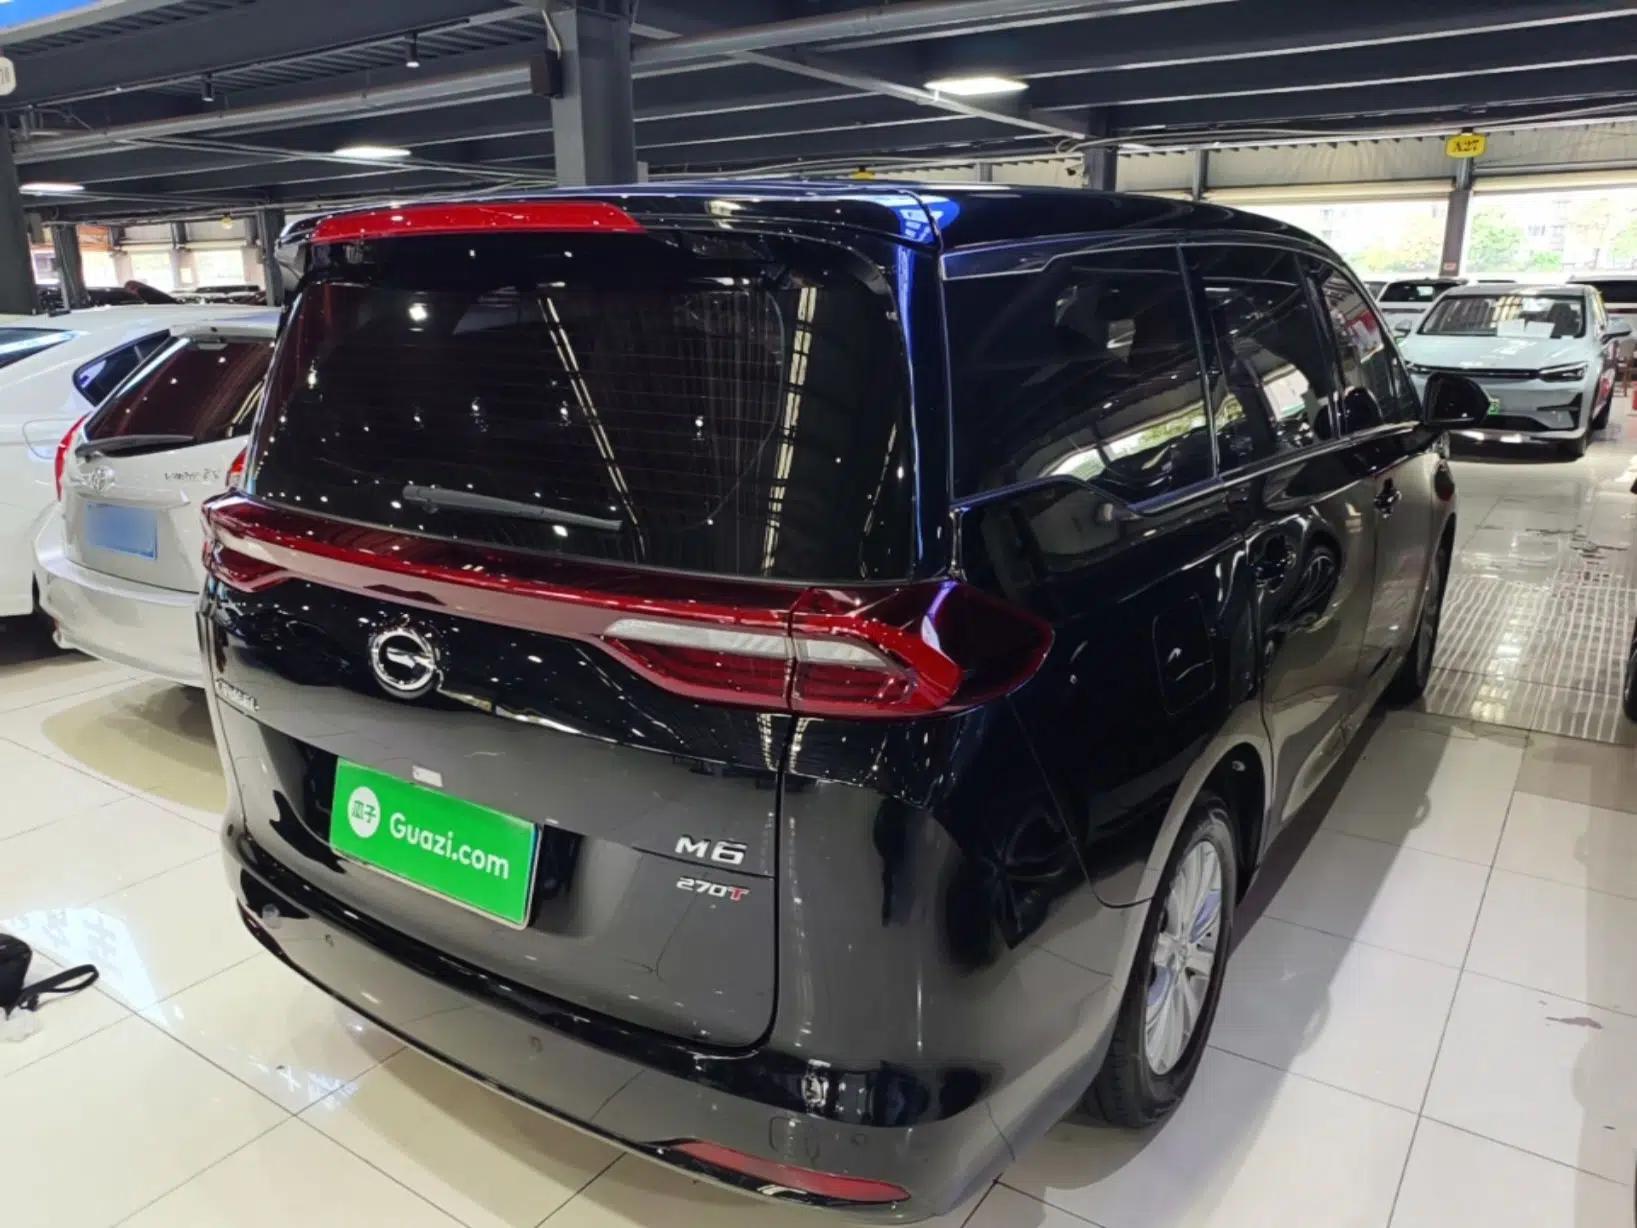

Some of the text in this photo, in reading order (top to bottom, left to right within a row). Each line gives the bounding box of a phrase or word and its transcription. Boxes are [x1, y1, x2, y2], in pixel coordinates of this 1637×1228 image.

[351, 799, 377, 824] 瓜子
[389, 811, 510, 880] Guazi.com
[675, 836, 748, 865] M6
[676, 877, 751, 902] 270T
